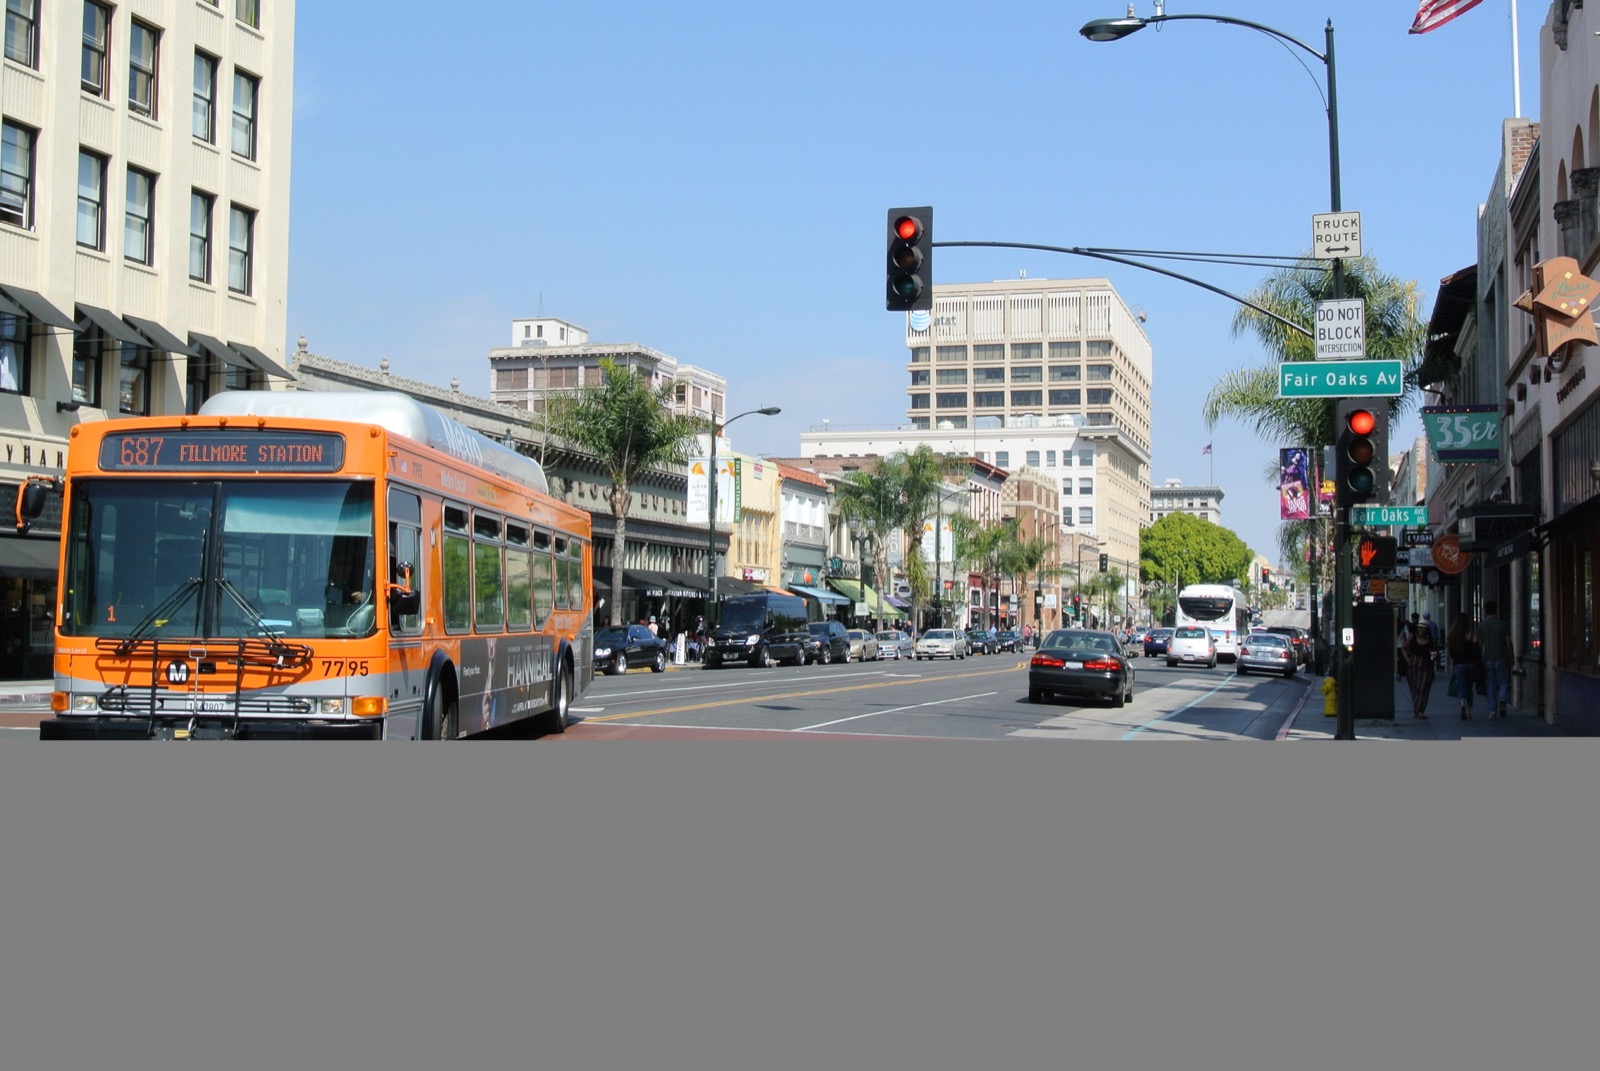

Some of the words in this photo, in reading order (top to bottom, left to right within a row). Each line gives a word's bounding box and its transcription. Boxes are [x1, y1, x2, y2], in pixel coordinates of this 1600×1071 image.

[1315, 218, 1358, 230] TRUCK
[1316, 232, 1358, 243] ROUTE
[1318, 309, 1334, 322] DO
[1338, 307, 1361, 321] NOT
[1319, 326, 1361, 341] BLOCK
[1318, 342, 1362, 353] INTERSECTION
[1284, 374, 1318, 387] Fair
[1326, 372, 1368, 387] Oaks
[1376, 371, 1398, 386] Av
[436, 412, 484, 466] Metro
[1436, 415, 1498, 448] 35er
[120, 437, 164, 466] 687
[180, 444, 248, 462] FILLMORE
[257, 445, 323, 462] STATION
[1354, 508, 1375, 522] Fair
[1381, 508, 1410, 522] Oaks
[1414, 508, 1425, 516] AVE
[1407, 534, 1433, 542] LUSH
[107, 606, 116, 622] 1
[321, 660, 369, 677] 7795
[507, 652, 552, 688] HANNIBAL
